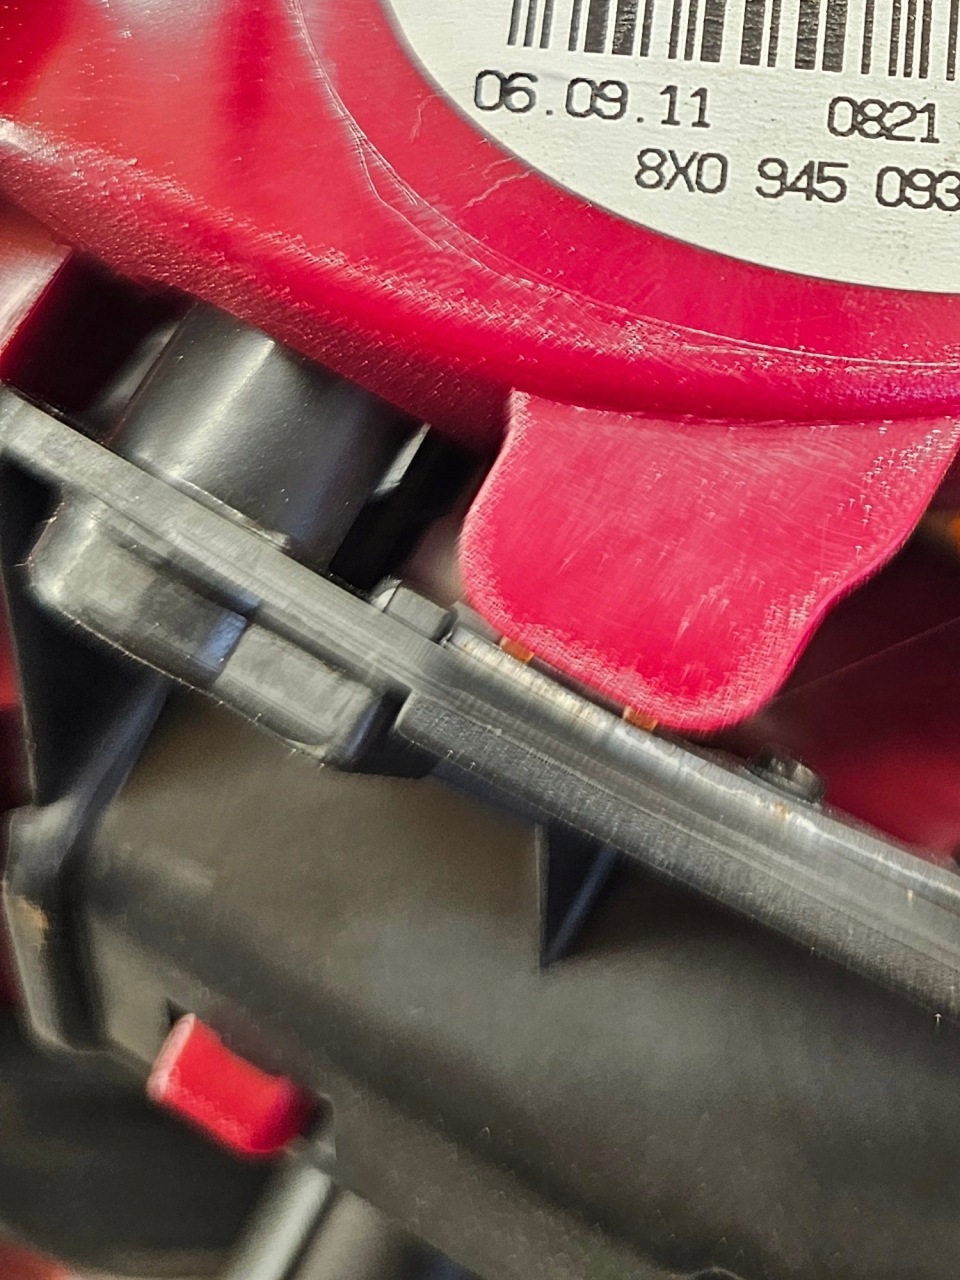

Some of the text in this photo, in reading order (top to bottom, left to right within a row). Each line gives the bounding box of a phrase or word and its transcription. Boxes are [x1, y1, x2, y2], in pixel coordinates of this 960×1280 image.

[828, 95, 940, 144] 0821
[634, 147, 729, 194] 8X0
[755, 157, 849, 204] 945
